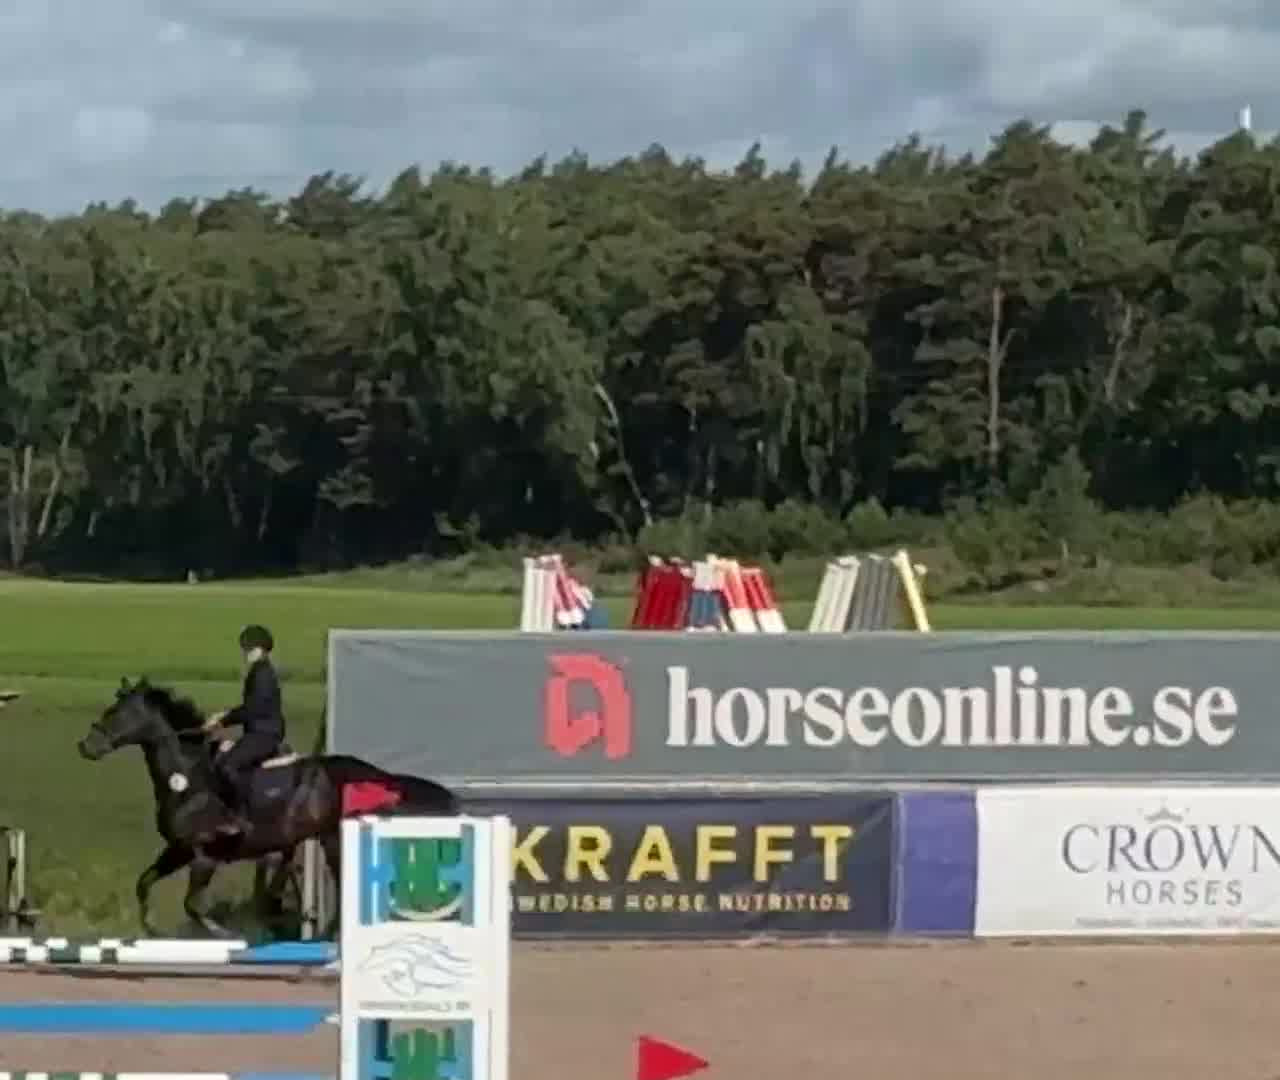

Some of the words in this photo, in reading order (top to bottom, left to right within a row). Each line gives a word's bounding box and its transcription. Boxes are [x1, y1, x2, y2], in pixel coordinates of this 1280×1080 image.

[666, 666, 1238, 748] horseonline.se
[511, 825, 854, 882] KRAFFT
[510, 894, 614, 913] WEDISH
[719, 894, 852, 913] NUTRITION
[1106, 880, 1243, 905] HORSES
